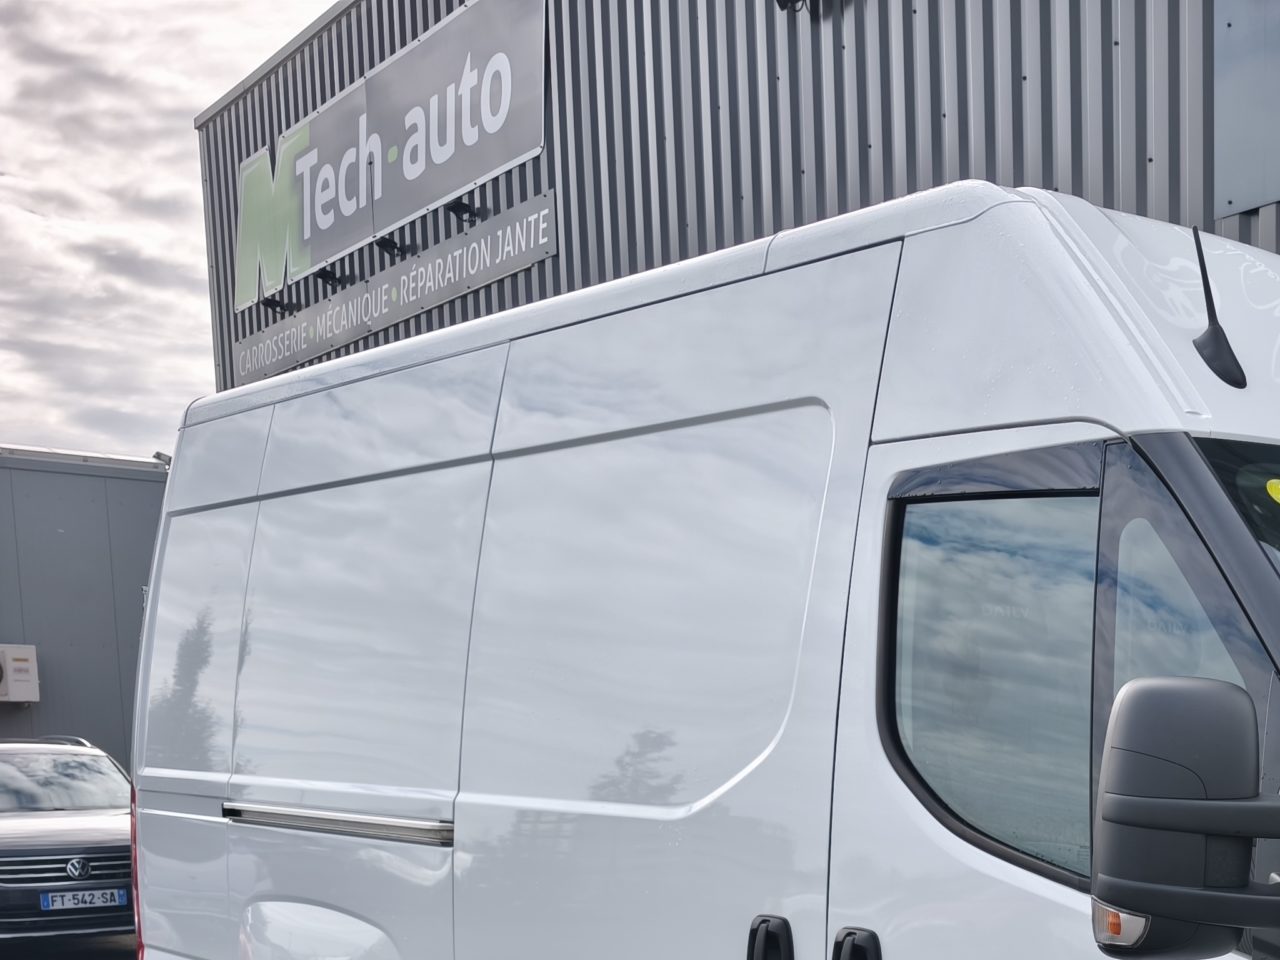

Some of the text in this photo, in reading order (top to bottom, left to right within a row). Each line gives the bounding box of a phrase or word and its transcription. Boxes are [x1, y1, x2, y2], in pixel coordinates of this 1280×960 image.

[239, 209, 549, 376] CARROSSERIE MÉCANIQUE RÉPARATION JANTE
